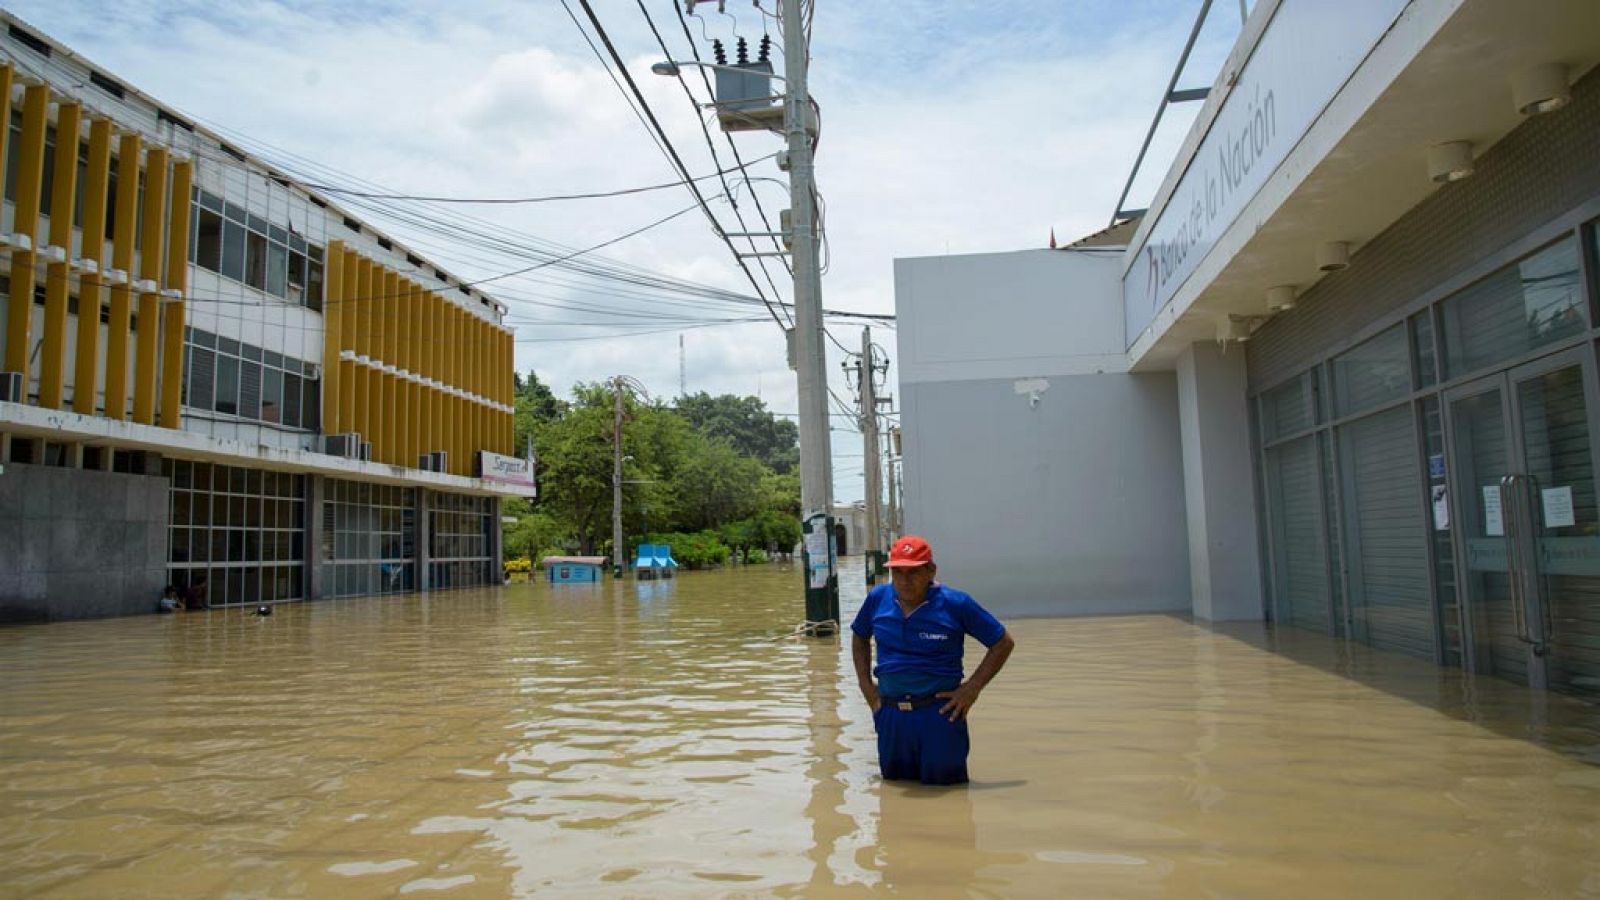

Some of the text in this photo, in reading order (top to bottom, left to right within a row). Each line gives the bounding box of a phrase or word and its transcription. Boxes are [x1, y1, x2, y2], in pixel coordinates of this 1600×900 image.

[1160, 83, 1276, 287] Banco de la Nación
